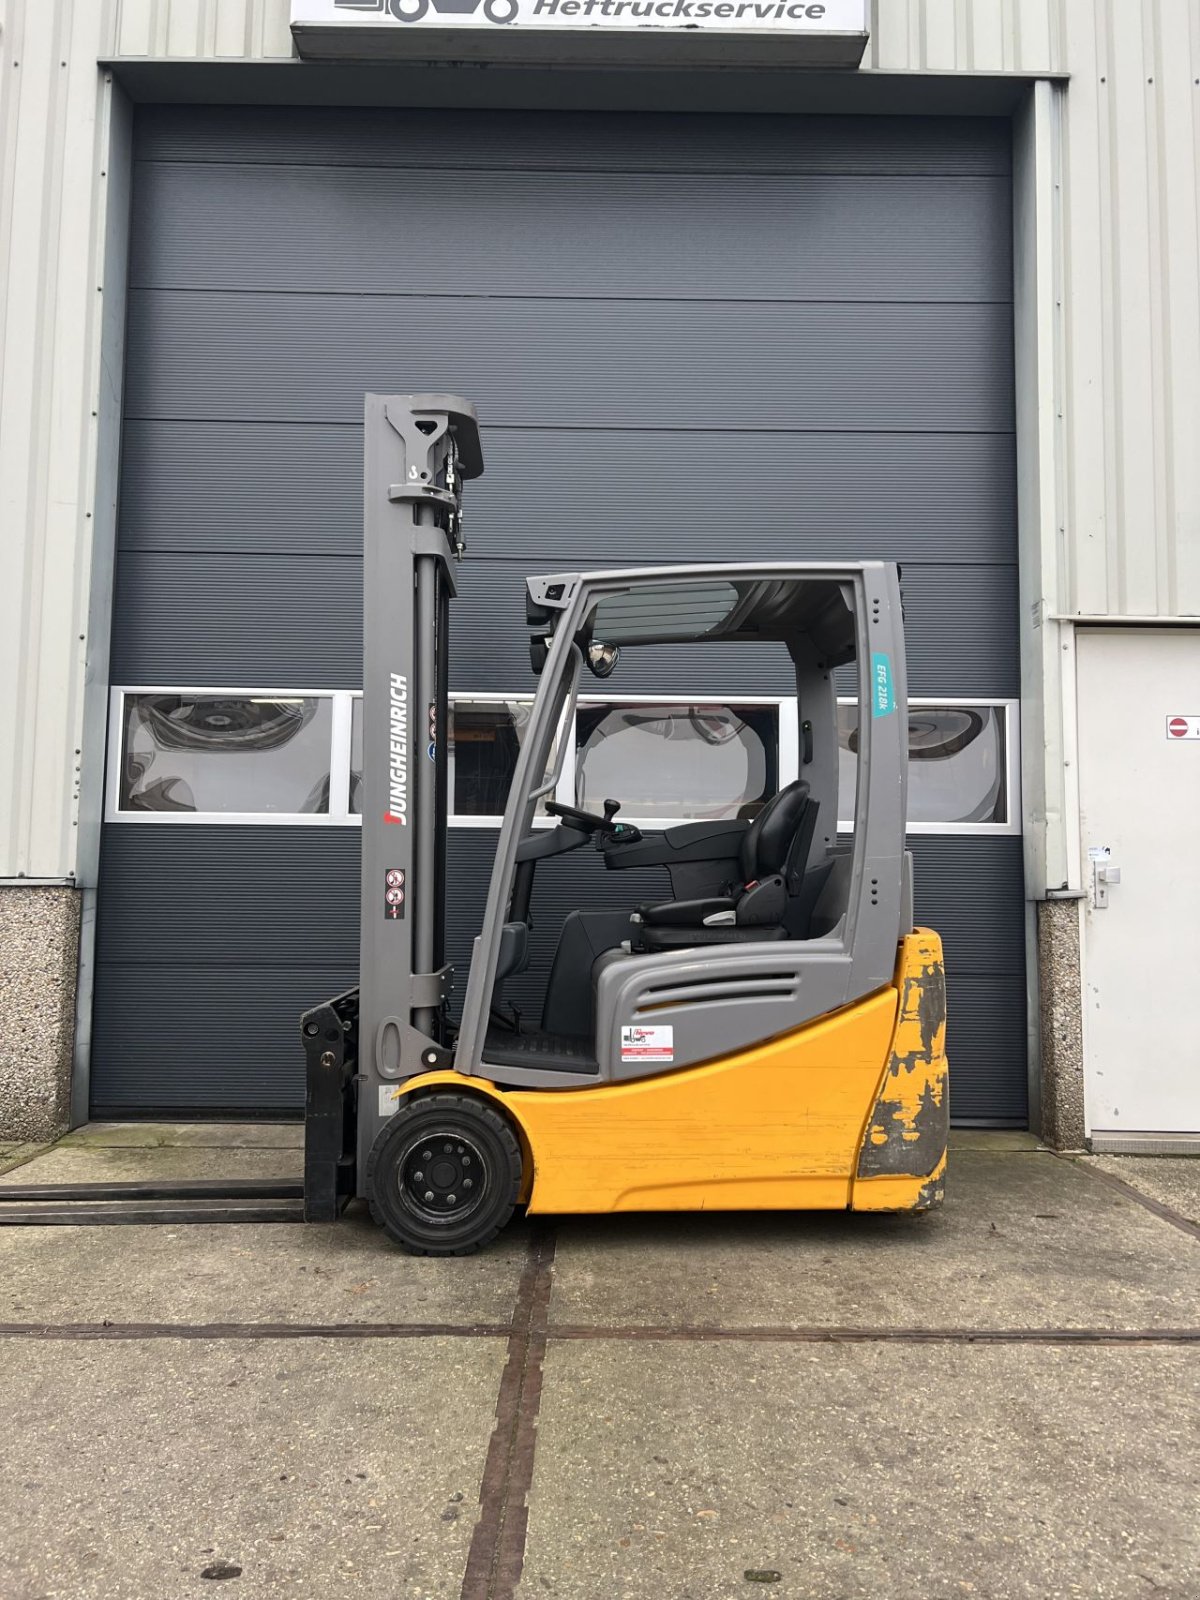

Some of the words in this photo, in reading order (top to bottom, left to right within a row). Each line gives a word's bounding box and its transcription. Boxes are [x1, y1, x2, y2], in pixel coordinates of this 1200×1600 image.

[532, 0, 826, 19] Heftruckservice
[876, 664, 887, 684] EFG
[384, 673, 407, 826] JUNGHEINRICH
